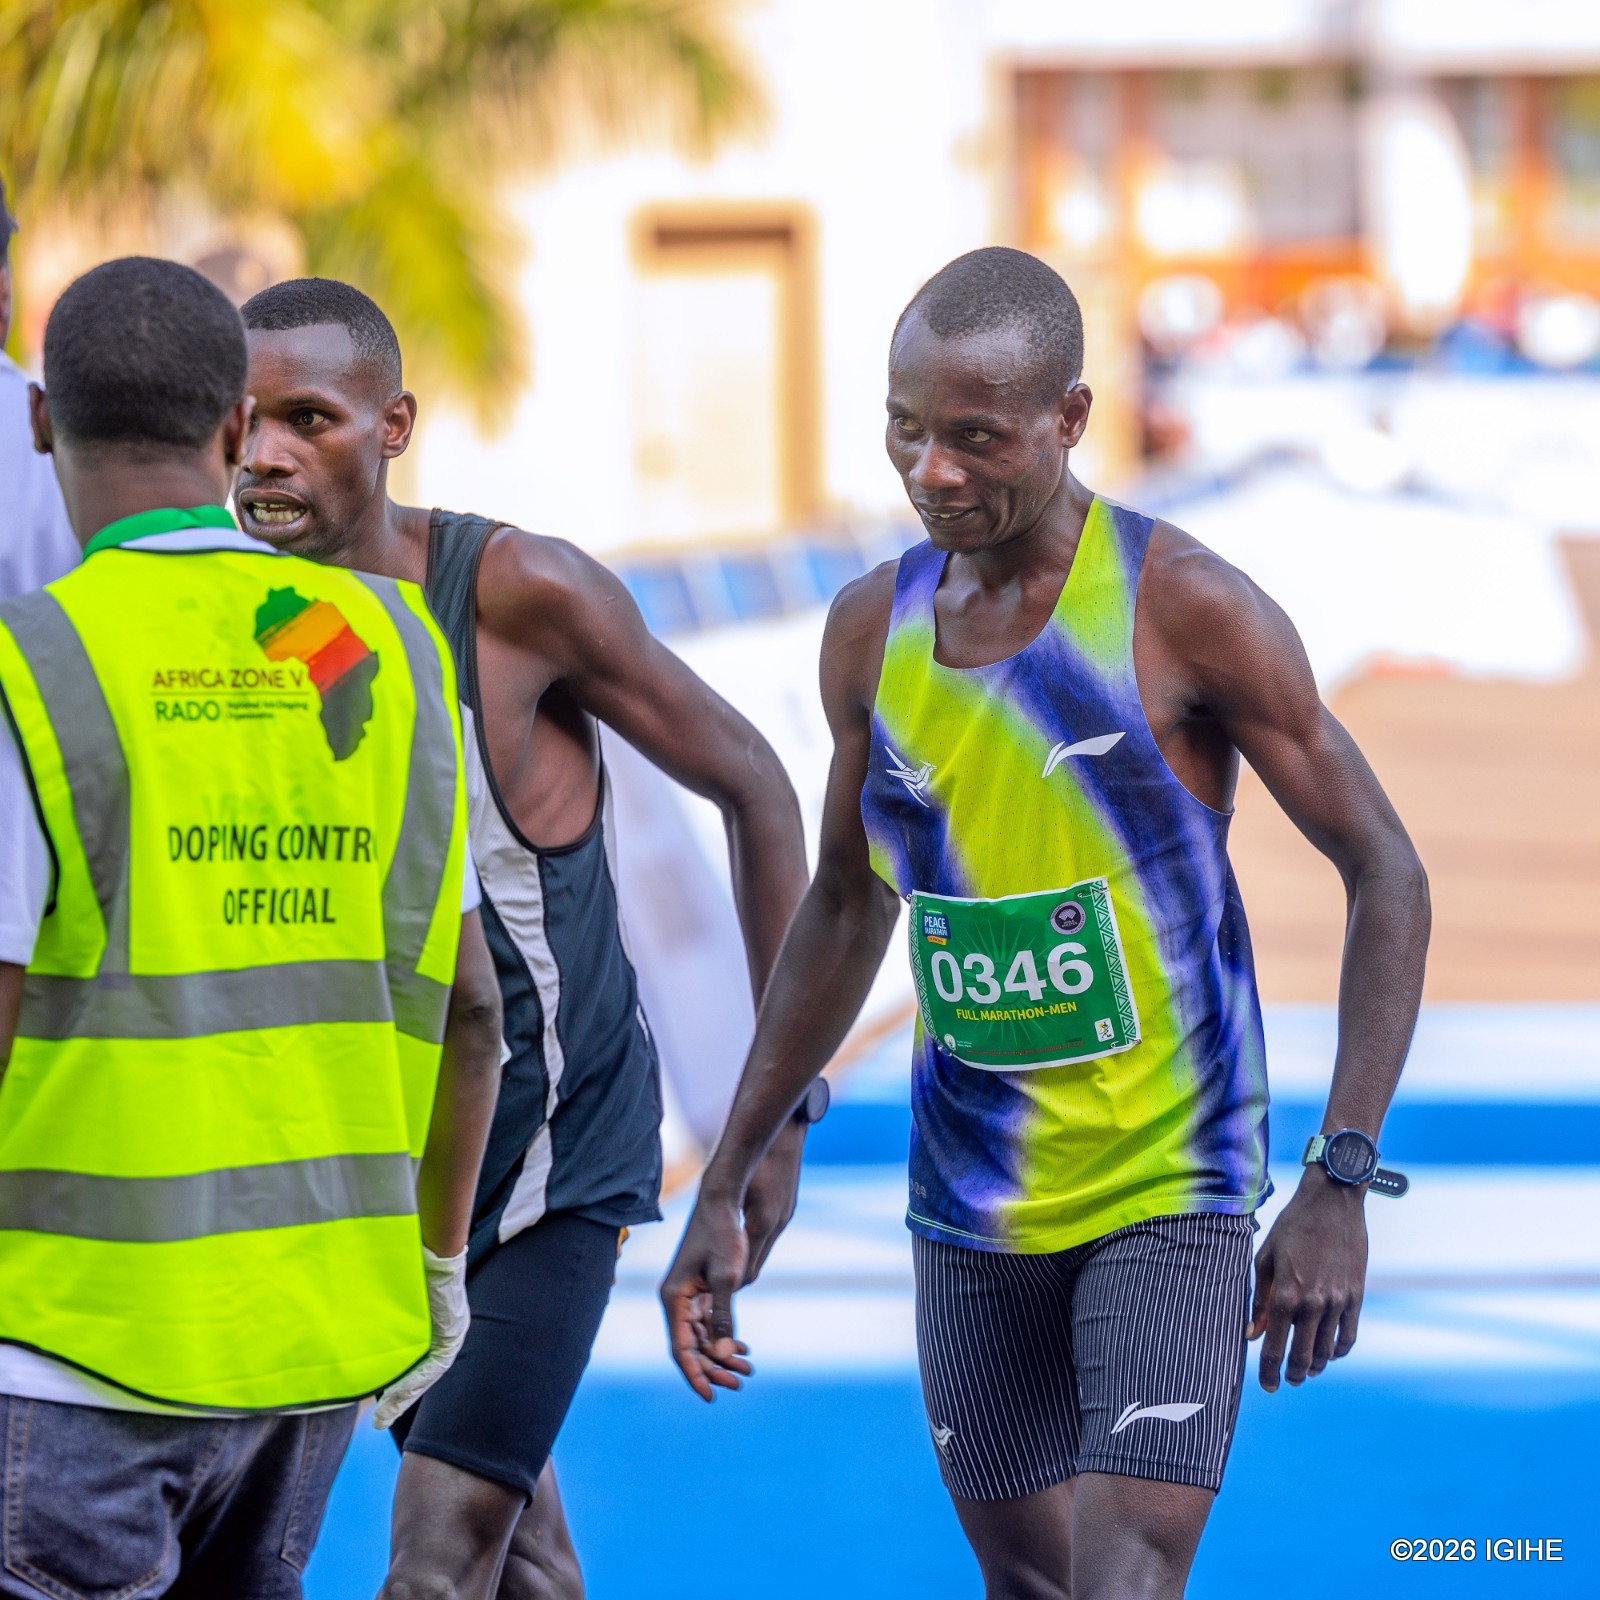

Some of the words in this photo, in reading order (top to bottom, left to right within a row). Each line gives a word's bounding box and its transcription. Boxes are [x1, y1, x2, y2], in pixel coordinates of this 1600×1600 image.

[153, 669, 225, 688] AFRICA
[230, 669, 285, 688] ZONE
[290, 670, 304, 687] V
[155, 700, 220, 721] RADO
[168, 825, 267, 862] DOPING
[277, 825, 378, 862] CONTR
[223, 887, 336, 925] OFFICIAL
[924, 915, 947, 929] PEACE
[931, 941, 1094, 1004] 0346
[956, 1008, 980, 1021] FULL
[980, 1001, 1078, 1021] MARATHON-MEN
